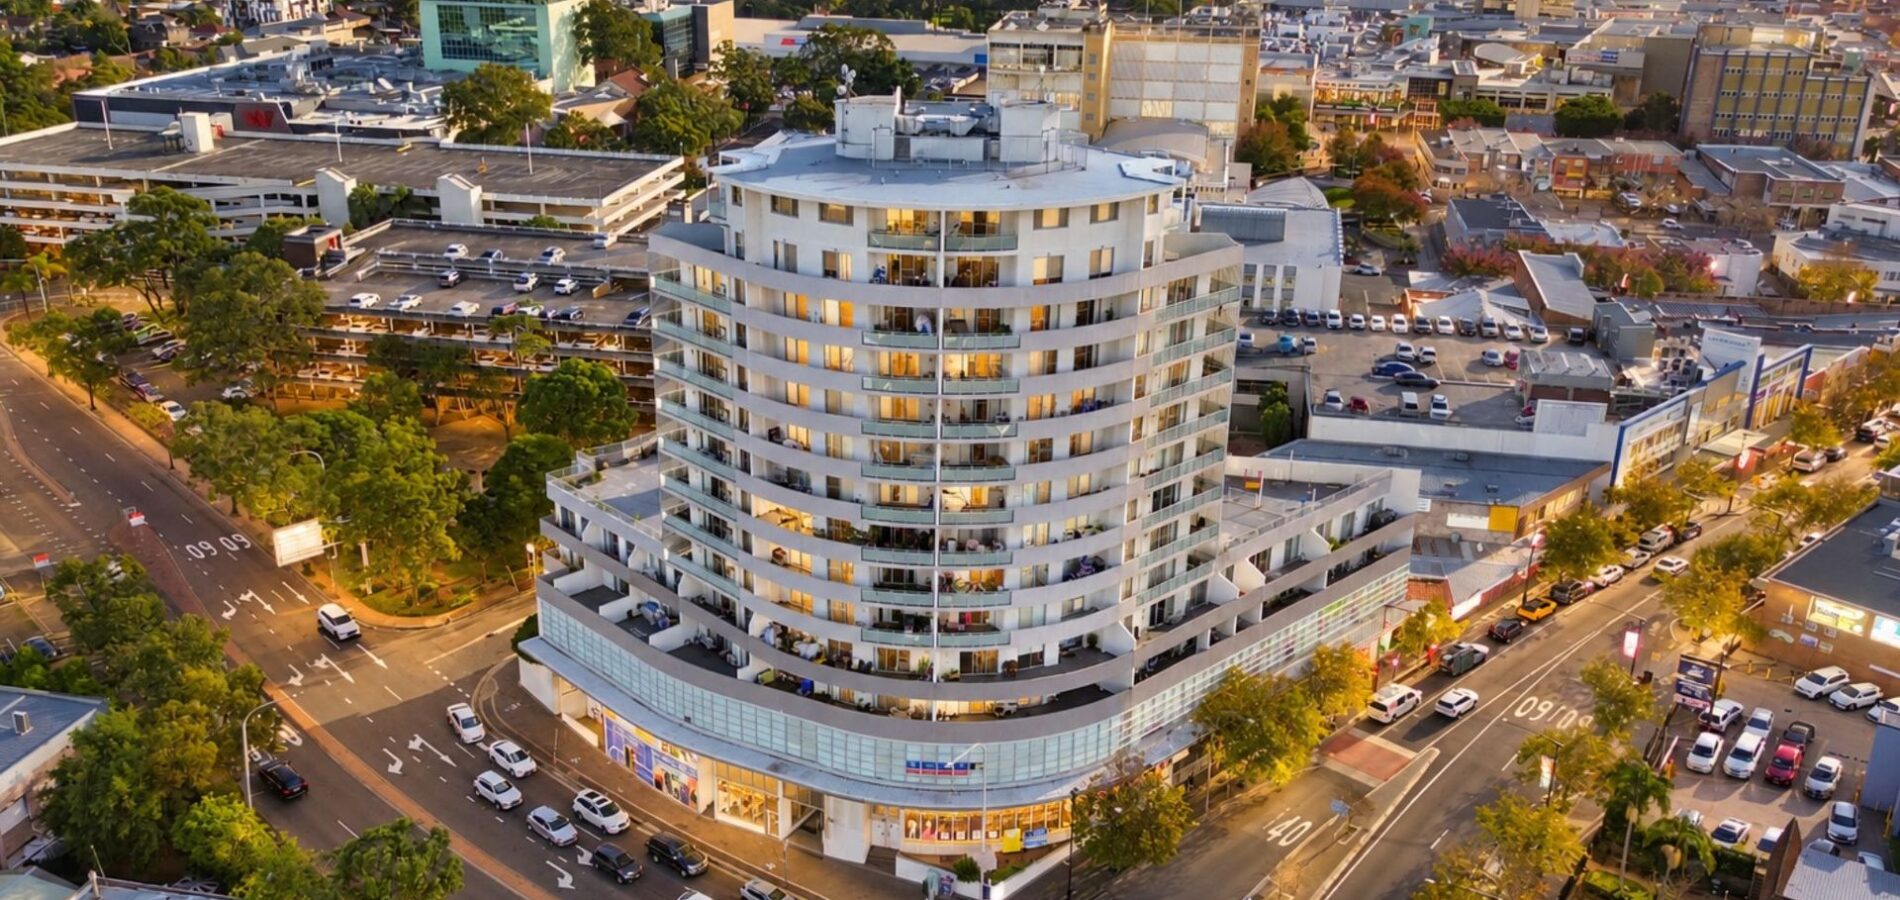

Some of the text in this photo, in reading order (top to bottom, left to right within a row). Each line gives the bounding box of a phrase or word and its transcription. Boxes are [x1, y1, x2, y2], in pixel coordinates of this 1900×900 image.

[185, 541, 218, 558] 60
[219, 533, 251, 552] 60
[1514, 696, 1554, 721] 60
[1267, 815, 1312, 846] 40
